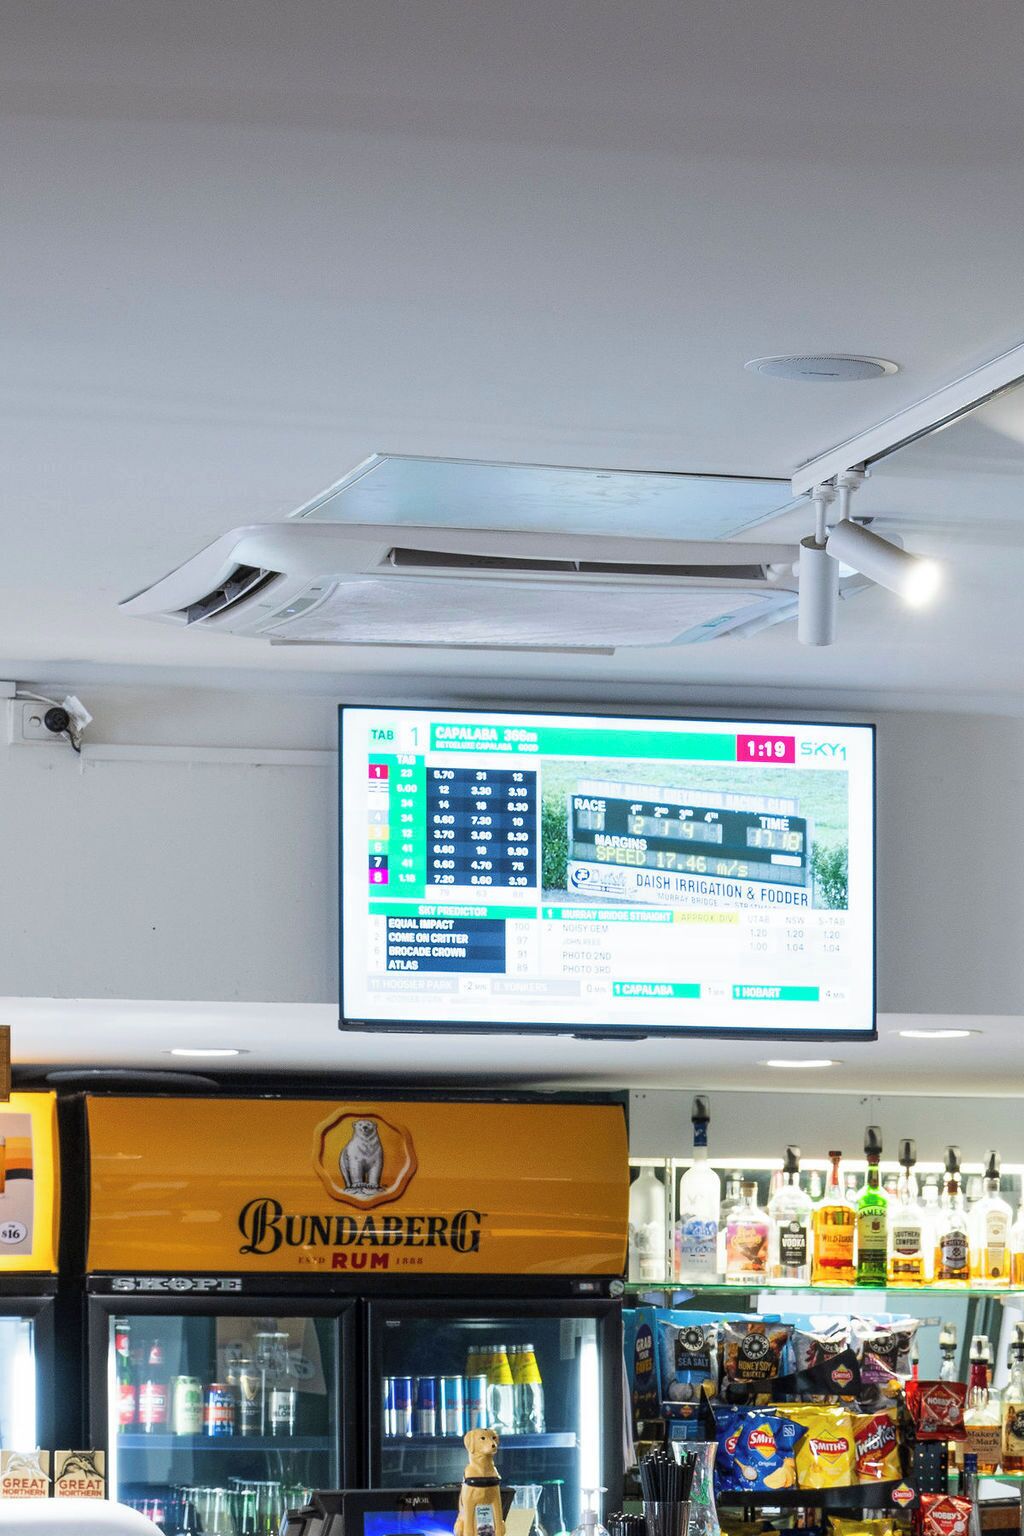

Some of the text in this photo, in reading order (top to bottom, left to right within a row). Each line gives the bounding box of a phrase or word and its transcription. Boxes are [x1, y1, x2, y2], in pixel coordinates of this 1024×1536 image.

[371, 729, 394, 740] TAB
[436, 727, 498, 740] CAPALABA
[748, 741, 786, 758] 1:19
[397, 754, 416, 765] TAB
[375, 767, 523, 782] 1 23 31 12
[439, 785, 449, 794] 12
[508, 788, 527, 797] 3.10
[439, 800, 449, 809] 14
[574, 798, 606, 813] RACE
[471, 816, 492, 825] 7.30
[759, 816, 789, 831] TIME
[402, 829, 412, 837] 12
[434, 830, 455, 839] 3.70
[595, 834, 648, 850] MARGINS
[402, 844, 413, 852] 41
[374, 857, 382, 867] 7
[471, 861, 492, 870] 4.70
[596, 846, 749, 877] SPEED 17.46 m/s
[374, 872, 382, 883] 8
[636, 873, 809, 906] DAISH IRRIGATION & FODDER
[418, 905, 488, 916] SKY PREDICTOR
[561, 910, 596, 920] MURRAY
[598, 910, 628, 921] BRIDGE
[629, 911, 673, 922] STRAIGHT
[388, 918, 419, 929] EQUAL
[420, 919, 455, 930] IMPACT
[388, 932, 415, 943] COME
[416, 933, 430, 943] ON
[430, 933, 469, 944] CRITTER
[388, 946, 431, 957] BROCADE
[432, 947, 466, 958] CROWN
[562, 951, 592, 961] PHOTO
[388, 960, 419, 970] ATLAS
[562, 965, 592, 974] PHOTO
[615, 983, 674, 997] 1 CAPALABA
[735, 986, 741, 999] 1
[742, 986, 782, 1000] HOBART
[238, 1197, 482, 1256] BUNDABERG
[1, 1229, 21, 1239] $16
[781, 1238, 806, 1247] VODKA
[331, 1253, 389, 1270] RUM
[111, 1277, 242, 1292] SKOPE
[677, 1357, 710, 1367] SEA SALT
[738, 1360, 759, 1371] HONEY
[812, 1439, 848, 1451] SMITH'S
[975, 1438, 1000, 1446] Mark
[2, 1478, 46, 1488] GREAT
[59, 1479, 102, 1490] GREAT
[2, 1488, 46, 1496] NORTHERN
[59, 1489, 102, 1497] NORTHERN
[932, 1511, 962, 1520] NOBBY'S
